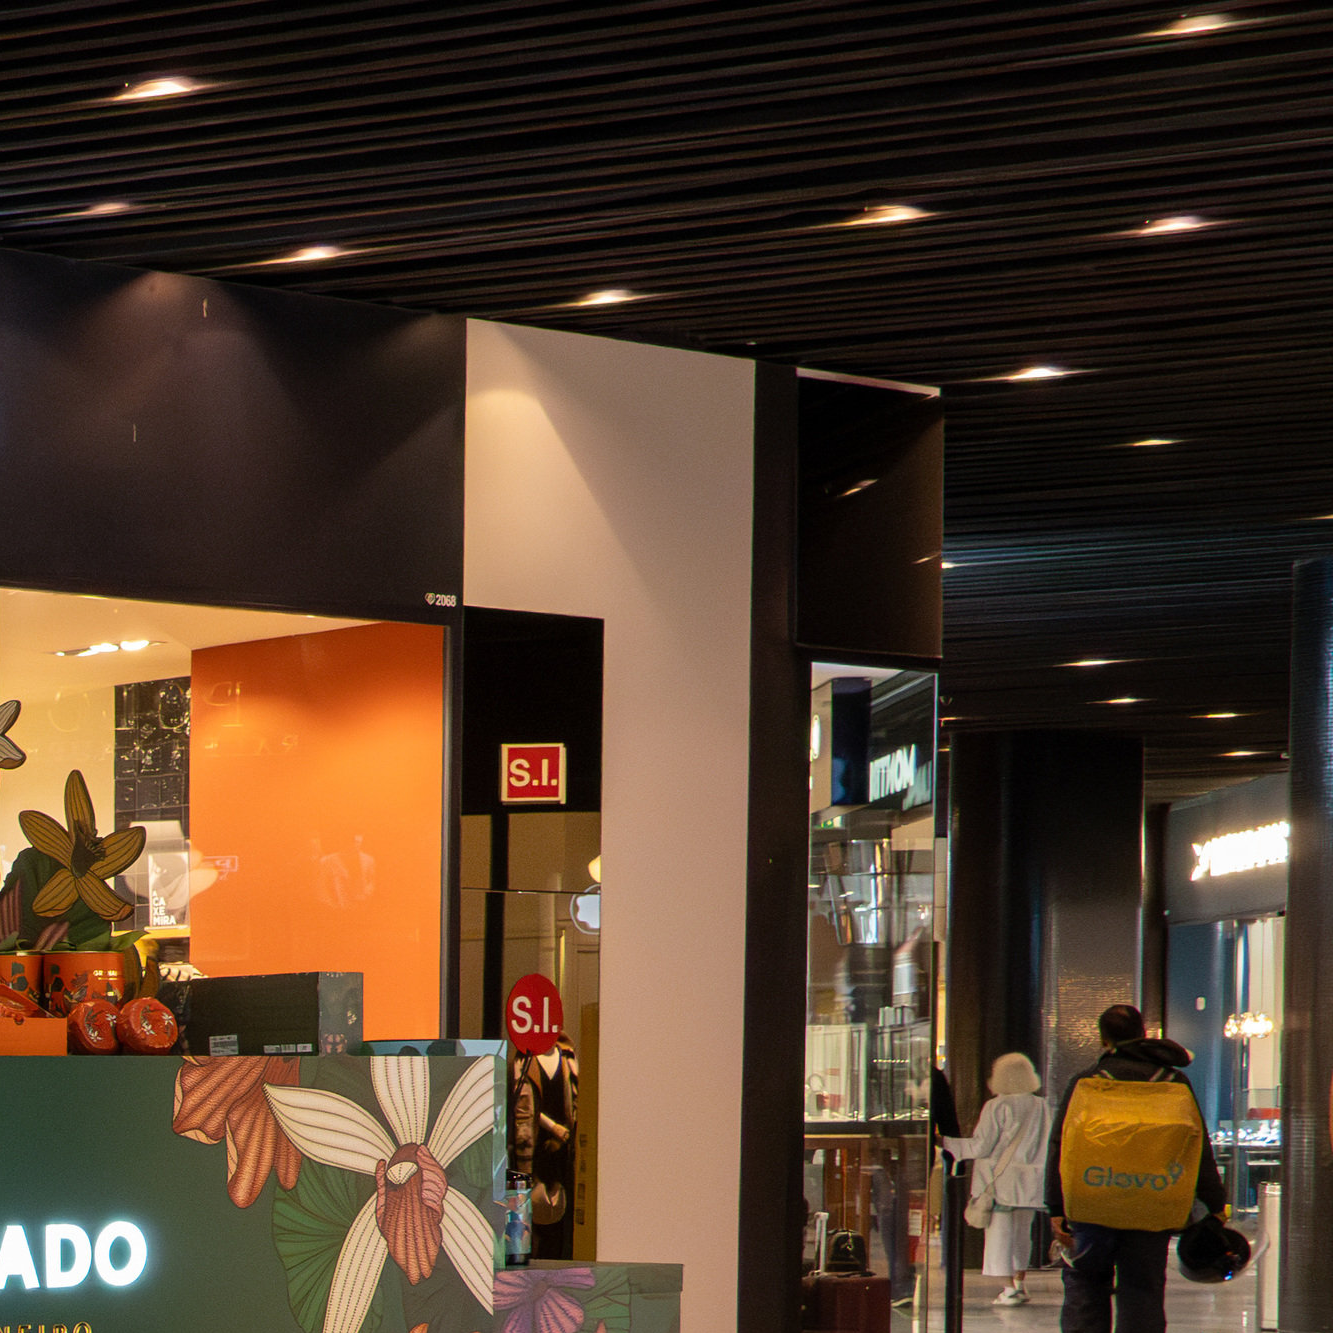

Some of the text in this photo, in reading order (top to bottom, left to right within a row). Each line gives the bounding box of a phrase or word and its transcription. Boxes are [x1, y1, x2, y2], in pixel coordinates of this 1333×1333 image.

[435, 593, 457, 607] 2068
[509, 758, 559, 787] S.I.
[152, 915, 177, 926] MIRA
[511, 995, 560, 1034] S.I.
[1083, 1166, 1169, 1191] Glovo
